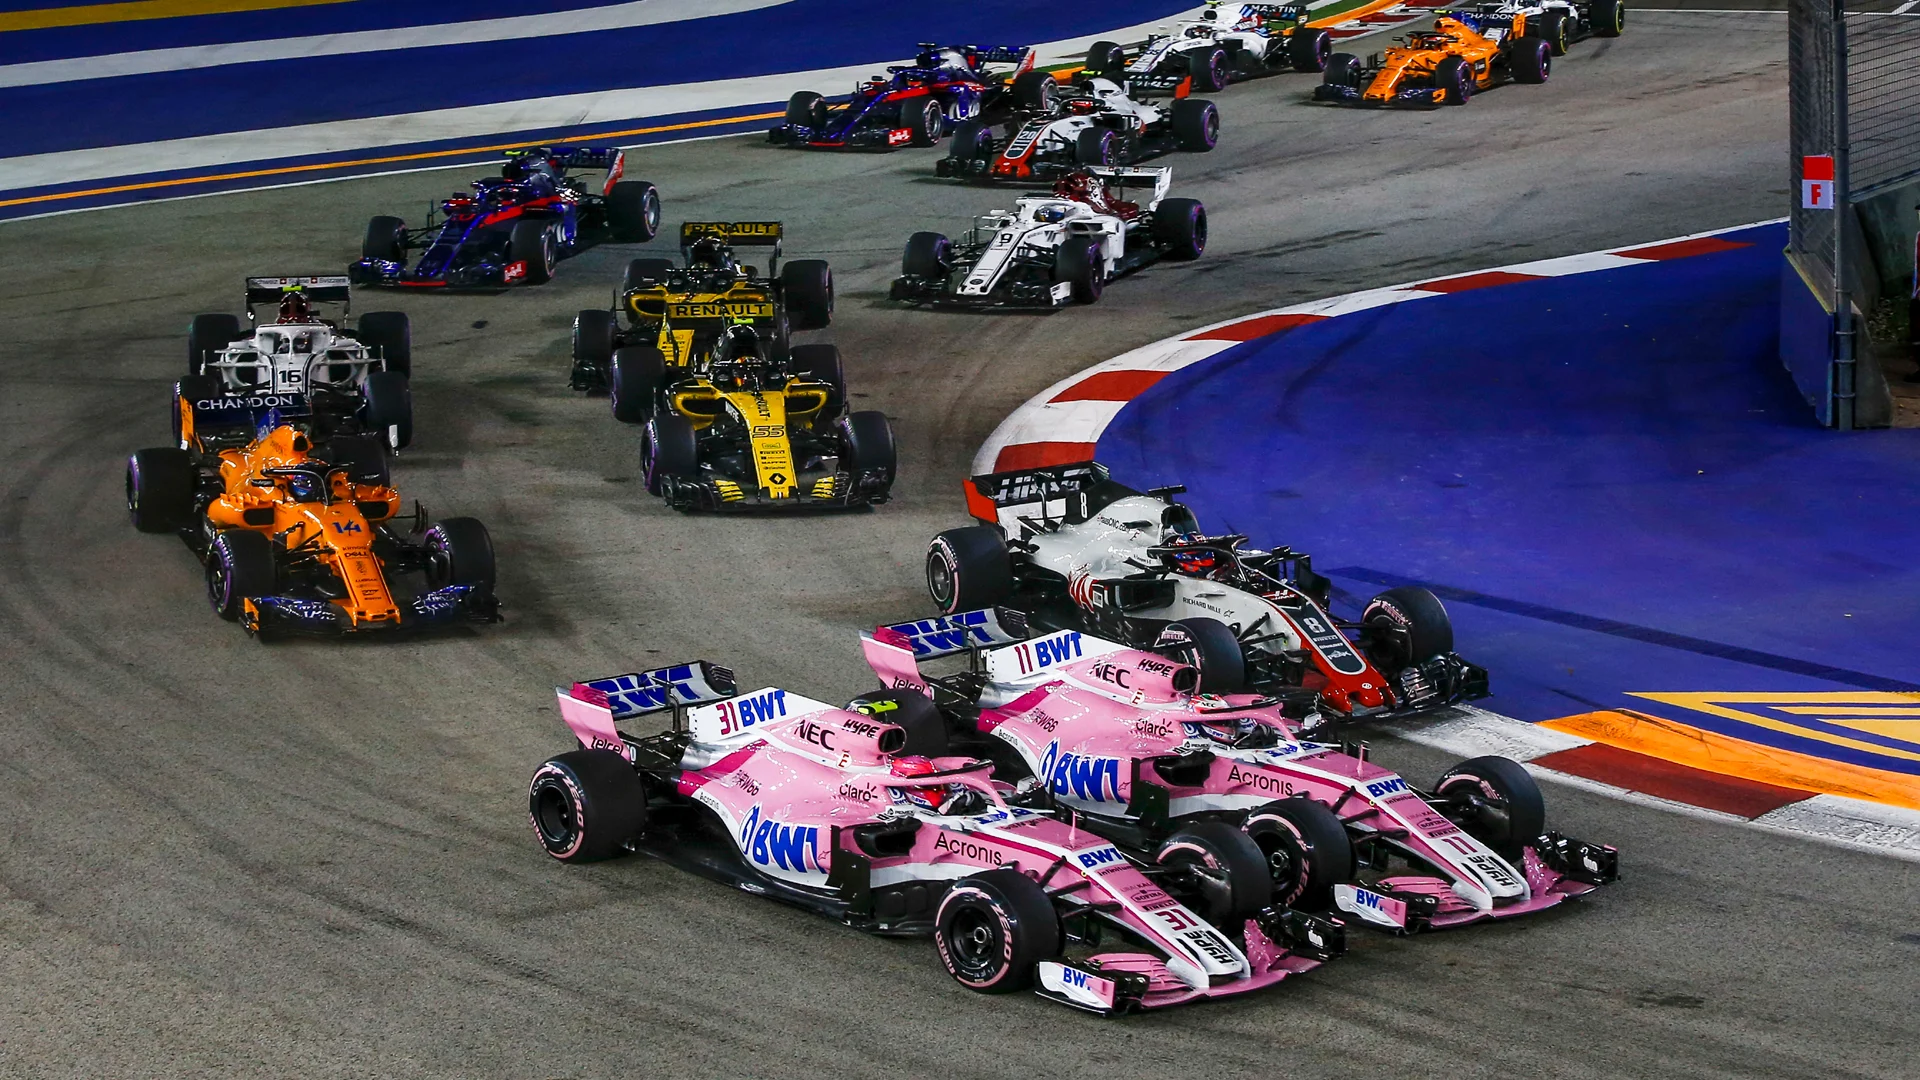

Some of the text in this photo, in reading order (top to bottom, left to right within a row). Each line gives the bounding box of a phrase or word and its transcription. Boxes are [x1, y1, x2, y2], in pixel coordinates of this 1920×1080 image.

[1465, 12, 1514, 20] HADON
[1018, 130, 1037, 139] 20
[1811, 183, 1822, 205] F
[999, 233, 1013, 247] 9
[675, 303, 767, 316] RENAULT
[278, 369, 301, 384] 16
[196, 395, 293, 411] CHANDON
[752, 425, 785, 438] 55
[1080, 492, 1087, 518] 8
[332, 520, 362, 534] 14
[1183, 597, 1221, 614] RICHARD MILLE
[890, 611, 996, 655] BWT
[1303, 617, 1326, 633] 8
[1015, 631, 1083, 674] 11 BWT
[1089, 660, 1131, 689] NEC
[1138, 659, 1173, 677] HYPE
[588, 664, 701, 715] BWT
[893, 676, 925, 692] telcel
[716, 689, 786, 736] 31 BWT
[794, 719, 835, 751] NEC
[842, 719, 880, 738] HYPE
[1136, 720, 1168, 737] Claro
[590, 735, 624, 755] telcel
[1054, 752, 1127, 804] BWT
[1228, 765, 1293, 796] Acronis
[1366, 778, 1409, 797] BWT
[840, 784, 872, 802] Claro
[753, 819, 829, 874] BWT
[934, 831, 1002, 866] Acronis
[1441, 836, 1478, 855] 11
[1079, 848, 1123, 868] BWT
[1467, 855, 1515, 886] HYPE
[1142, 899, 1176, 911] PIRELLI
[1155, 908, 1199, 931] 31
[1183, 930, 1236, 964] HYPE
